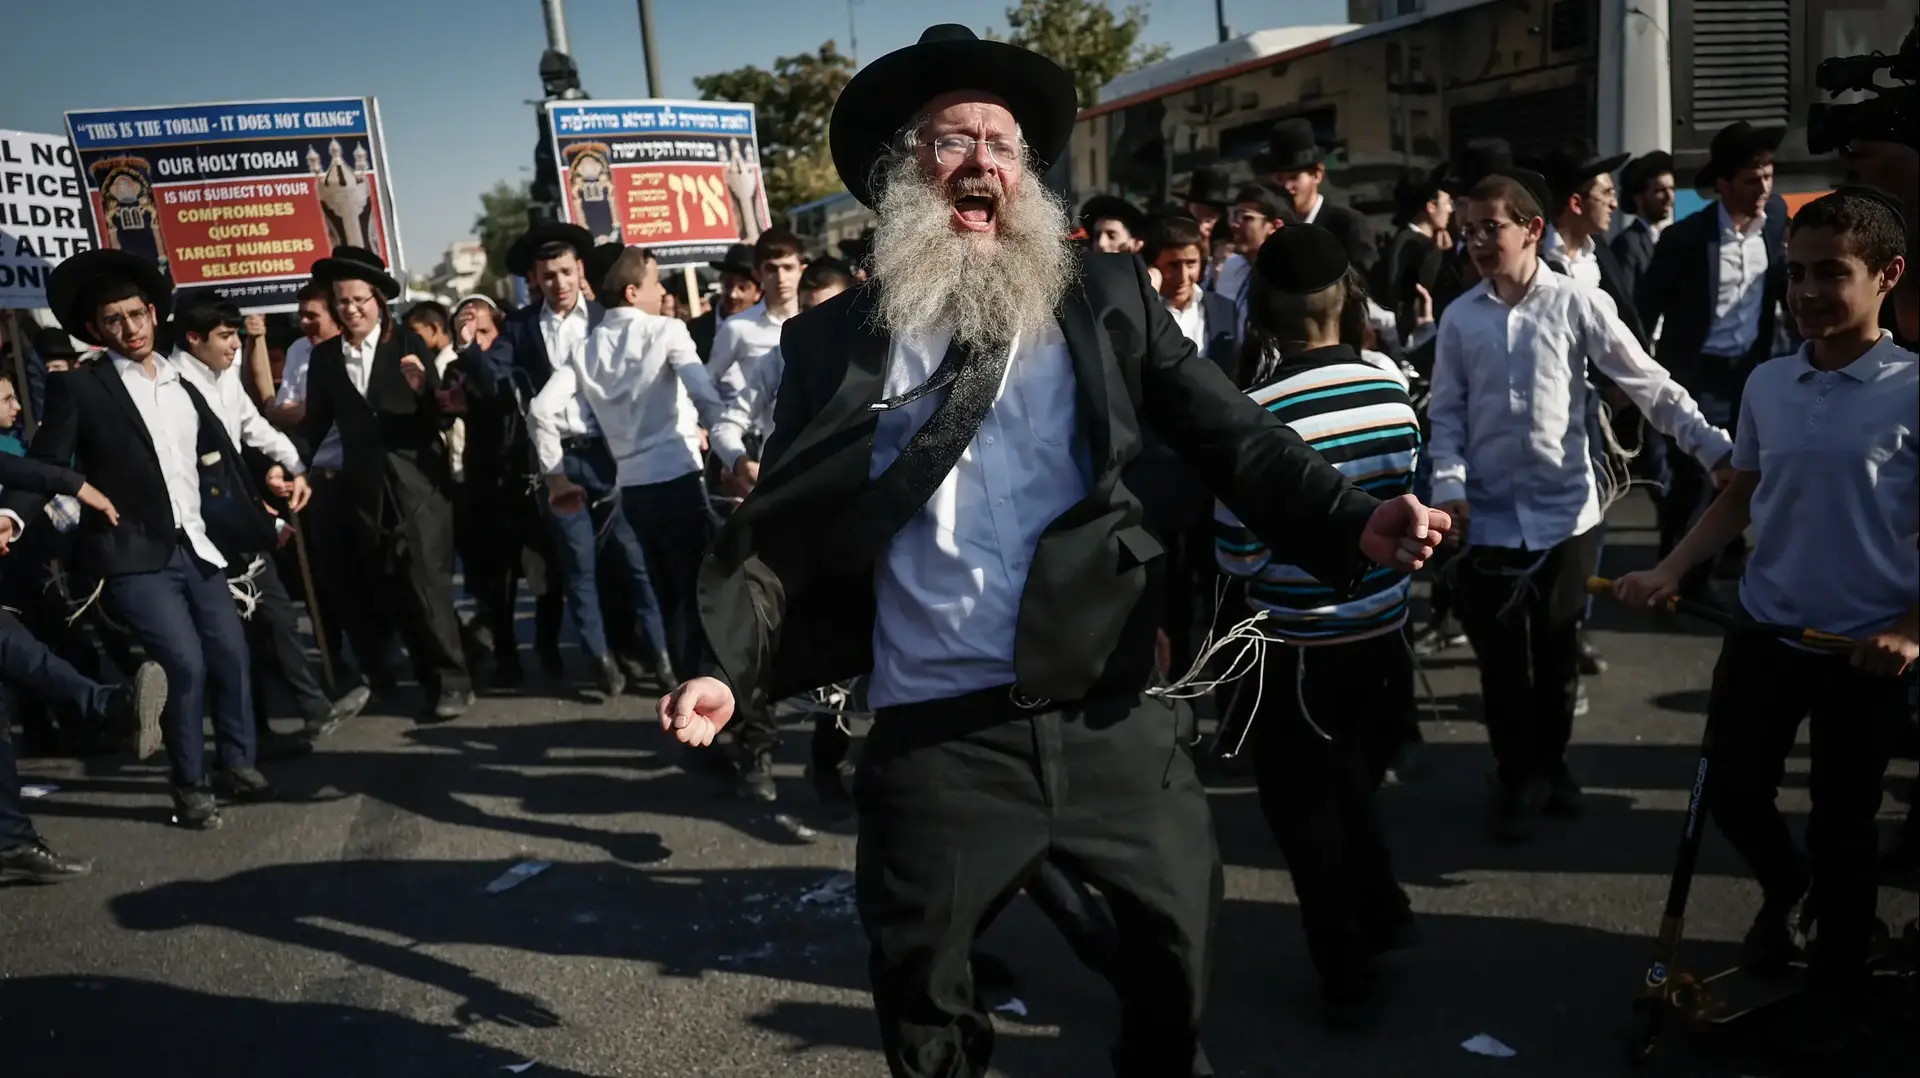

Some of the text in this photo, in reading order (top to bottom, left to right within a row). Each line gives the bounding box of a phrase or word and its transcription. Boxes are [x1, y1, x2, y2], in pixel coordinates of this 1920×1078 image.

[118, 121, 134, 138] IS
[134, 119, 162, 137] THE
[163, 117, 209, 135] TORAH
[220, 115, 235, 131] IT
[236, 113, 272, 131] DOES
[273, 112, 300, 129] NOT
[611, 140, 674, 159] הקדושה
[157, 150, 299, 175] OUR HOLY TORAH
[164, 182, 309, 204] IS NOT SUBJECT TO YOUR
[668, 173, 729, 234] אין
[177, 202, 295, 223] COMPROMISES
[208, 222, 270, 241] QUOTAS
[176, 238, 315, 261] TARGET NUMBERS
[201, 258, 296, 278] SELECTIONS
